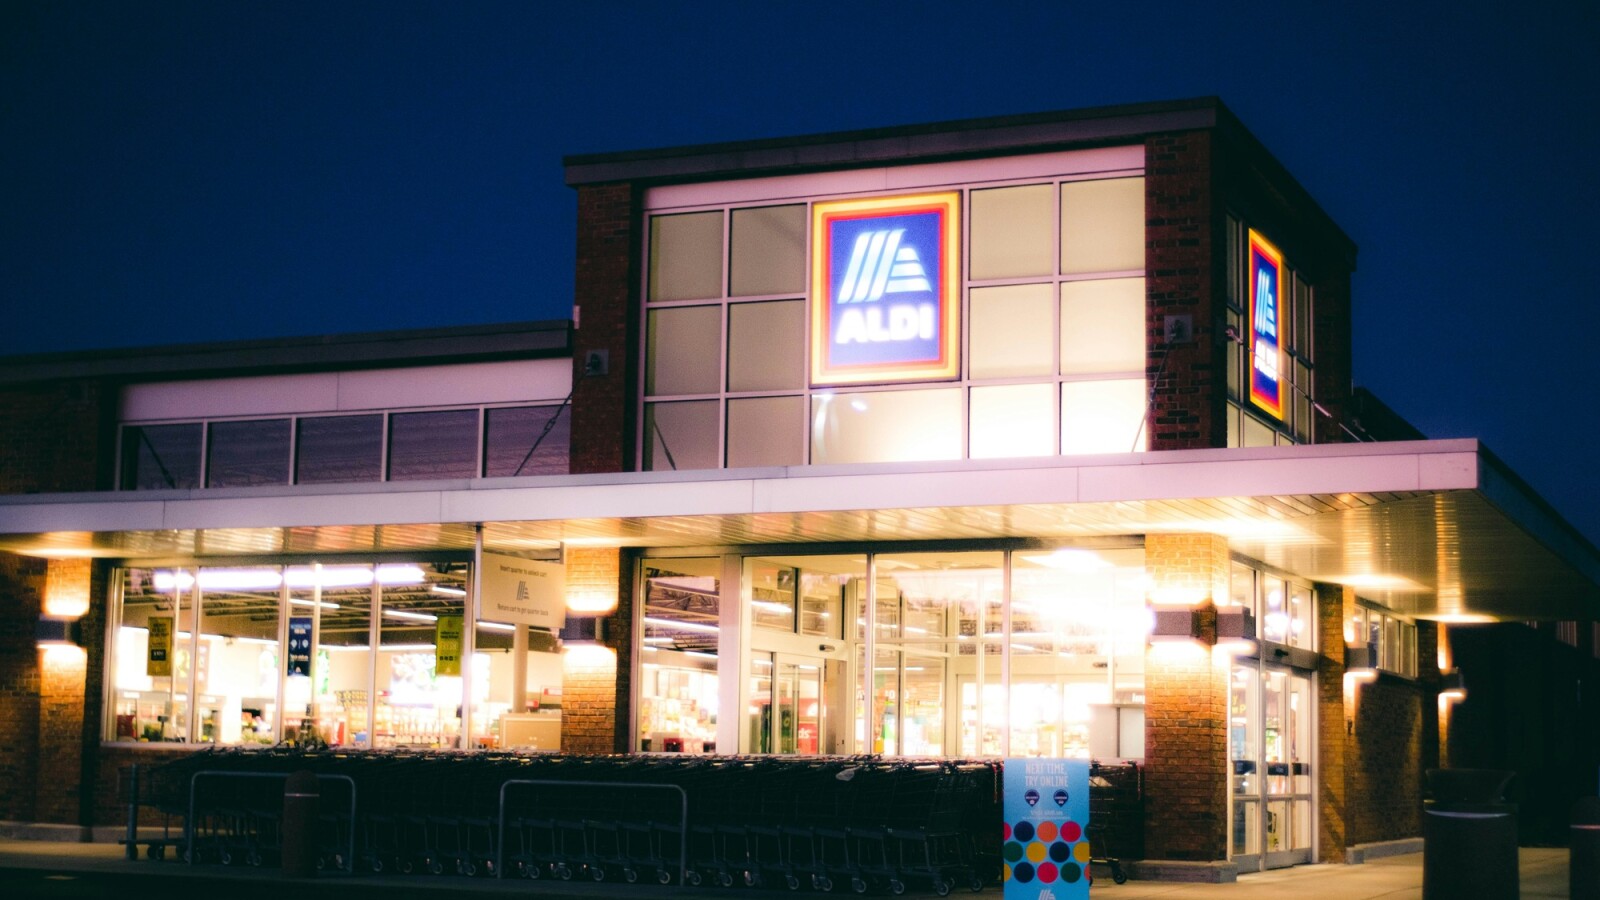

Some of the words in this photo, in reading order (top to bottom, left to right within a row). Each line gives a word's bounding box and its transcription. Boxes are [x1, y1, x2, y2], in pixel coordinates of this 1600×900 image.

[835, 303, 934, 344] ALDI
[1026, 762, 1042, 774] NEXT
[1025, 776, 1038, 786] TRY
[1040, 776, 1068, 786] ONLINE
